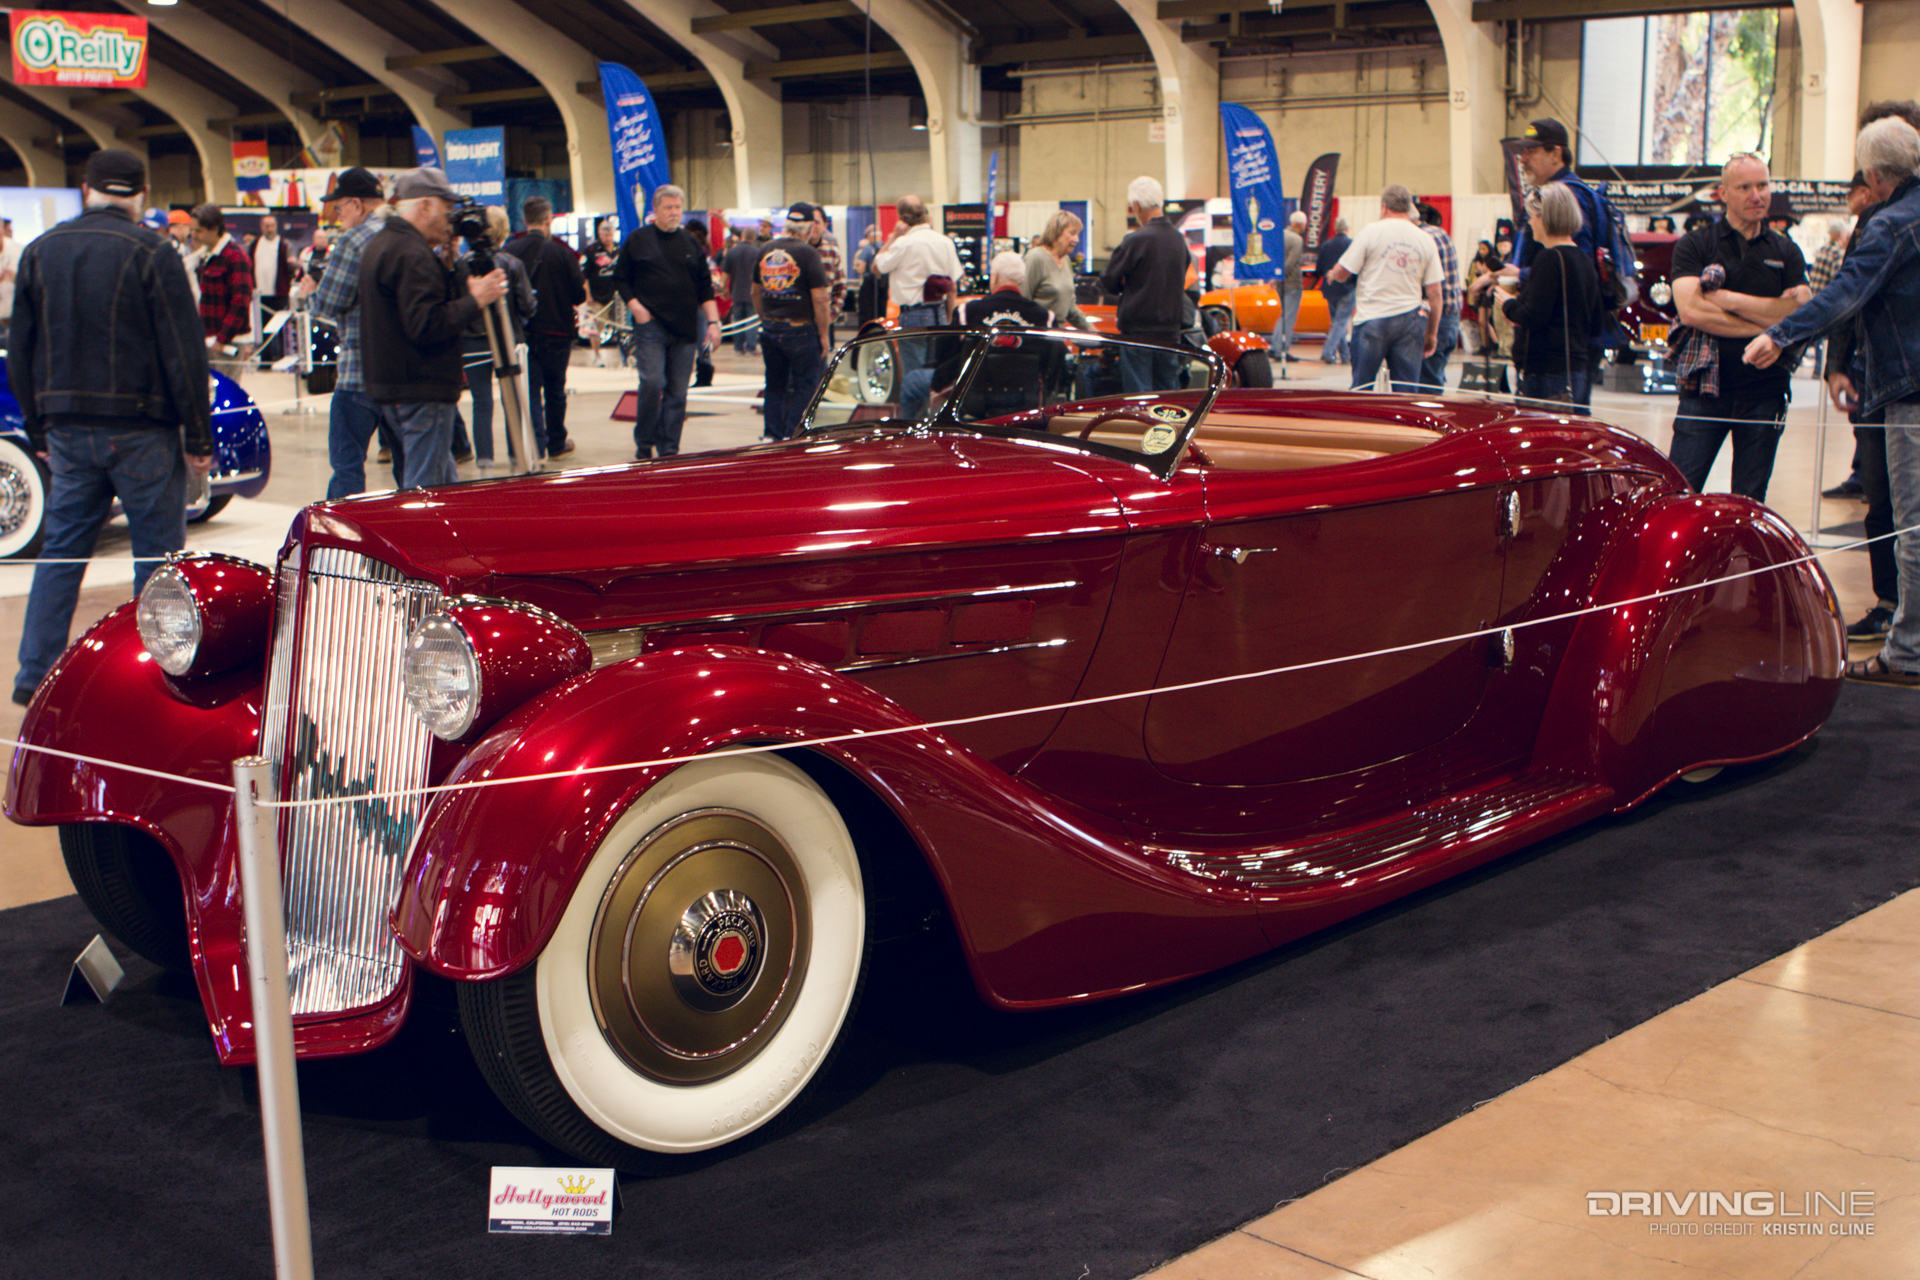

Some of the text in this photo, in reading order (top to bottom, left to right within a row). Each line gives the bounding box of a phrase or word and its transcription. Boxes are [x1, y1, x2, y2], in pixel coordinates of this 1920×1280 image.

[22, 22, 139, 72] O'Reilly
[1454, 90, 1466, 103] 22
[446, 145, 469, 161] BUD
[469, 142, 500, 159] LIGHT
[459, 183, 480, 196] COLD
[481, 181, 502, 195] BEER
[1626, 185, 1660, 198] Speed
[1662, 184, 1693, 197] Shop
[1307, 169, 1328, 249] UPHOLSTERY
[717, 914, 757, 948] PACKARD
[699, 958, 739, 990] PACKARD
[494, 1184, 608, 1210] Hollywood
[551, 1207, 599, 1217] HOT RODS
